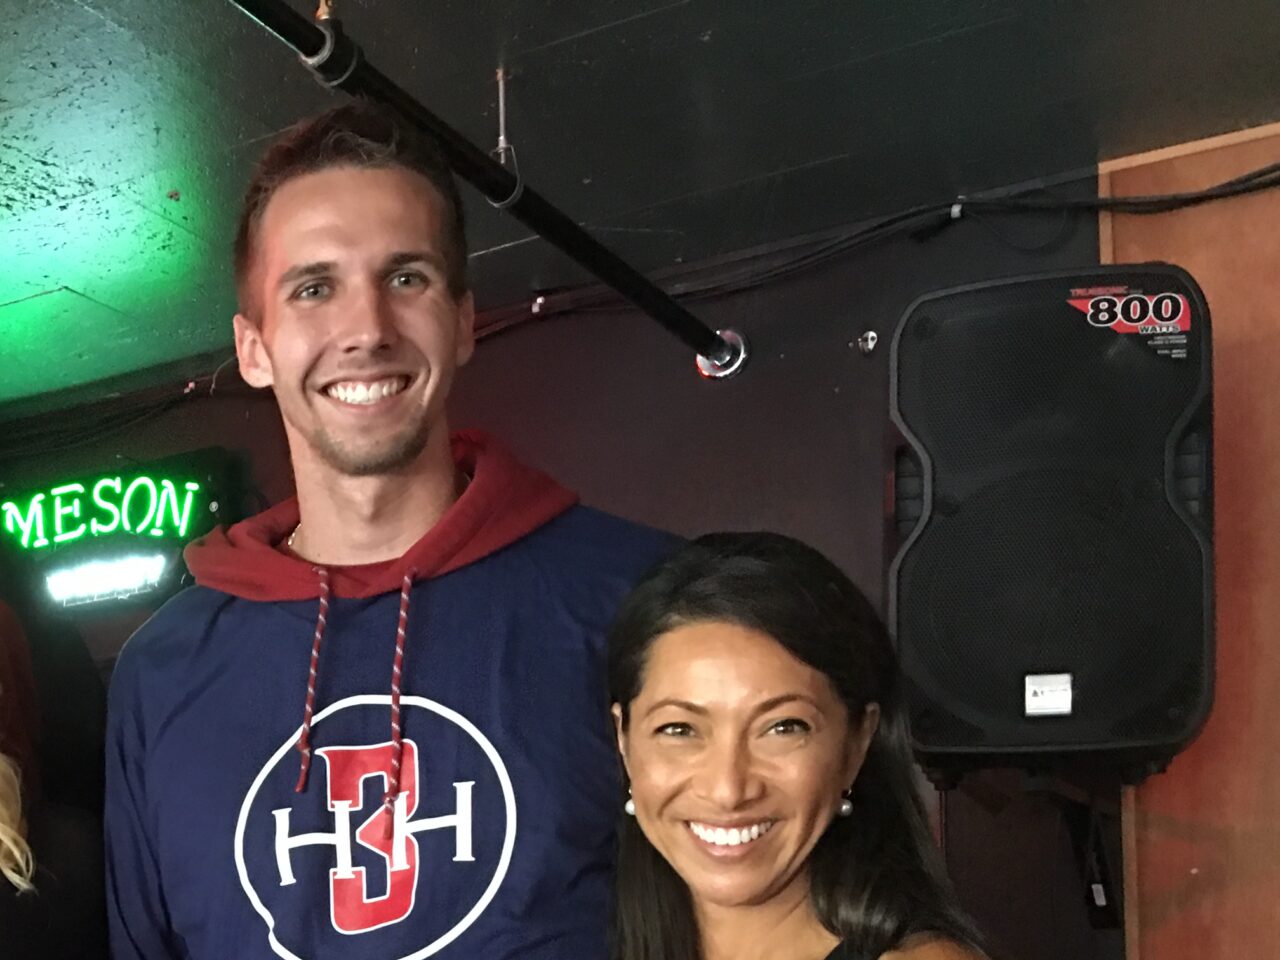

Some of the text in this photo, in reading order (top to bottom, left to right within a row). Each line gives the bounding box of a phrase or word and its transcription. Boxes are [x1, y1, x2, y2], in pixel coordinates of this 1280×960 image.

[1087, 293, 1183, 327] 800
[1138, 325, 1181, 334] WATTS
[1, 476, 200, 548] MESON
